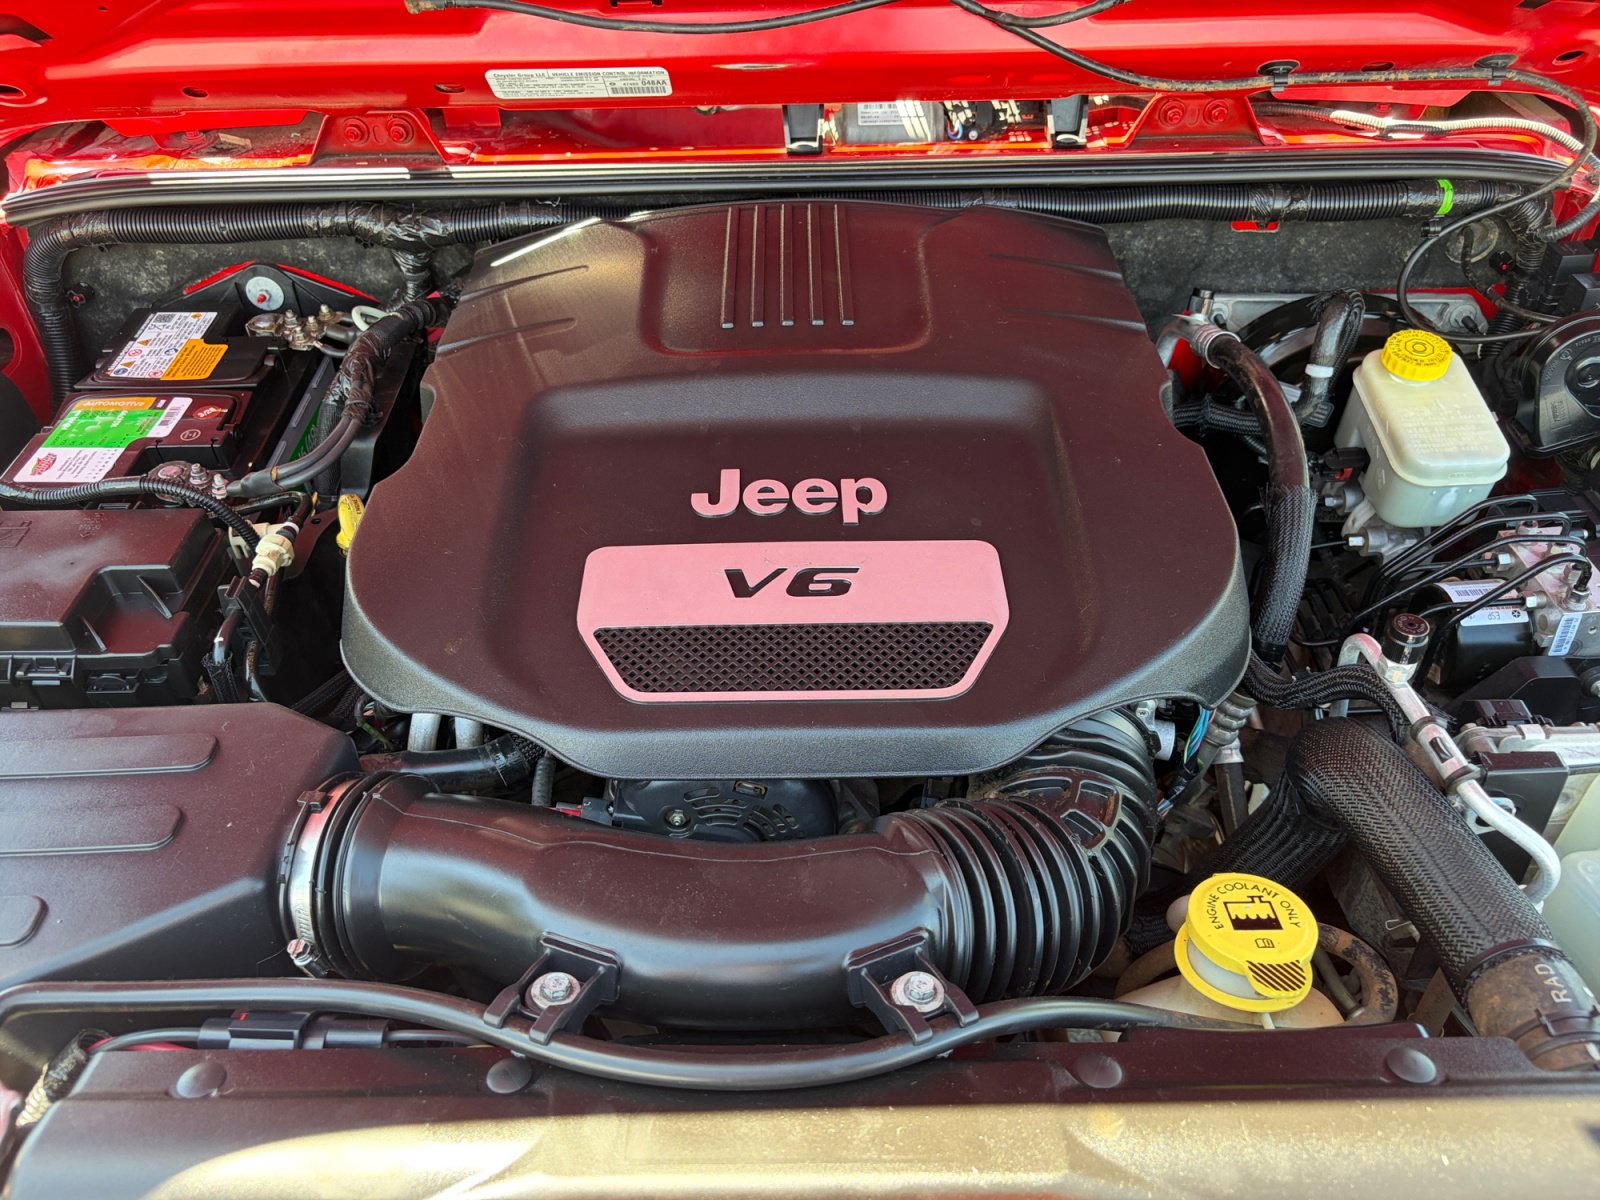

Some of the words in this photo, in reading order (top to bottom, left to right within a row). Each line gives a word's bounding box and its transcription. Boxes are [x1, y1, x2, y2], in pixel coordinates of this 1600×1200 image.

[83, 399, 145, 408] AUTOMOTIVE
[690, 468, 888, 526] Jeep
[723, 567, 860, 598] V6
[1206, 894, 1224, 930] ENGINE
[1216, 881, 1280, 899] COOLANT
[1279, 900, 1302, 929] ONLY
[1533, 963, 1573, 1003] RAD
